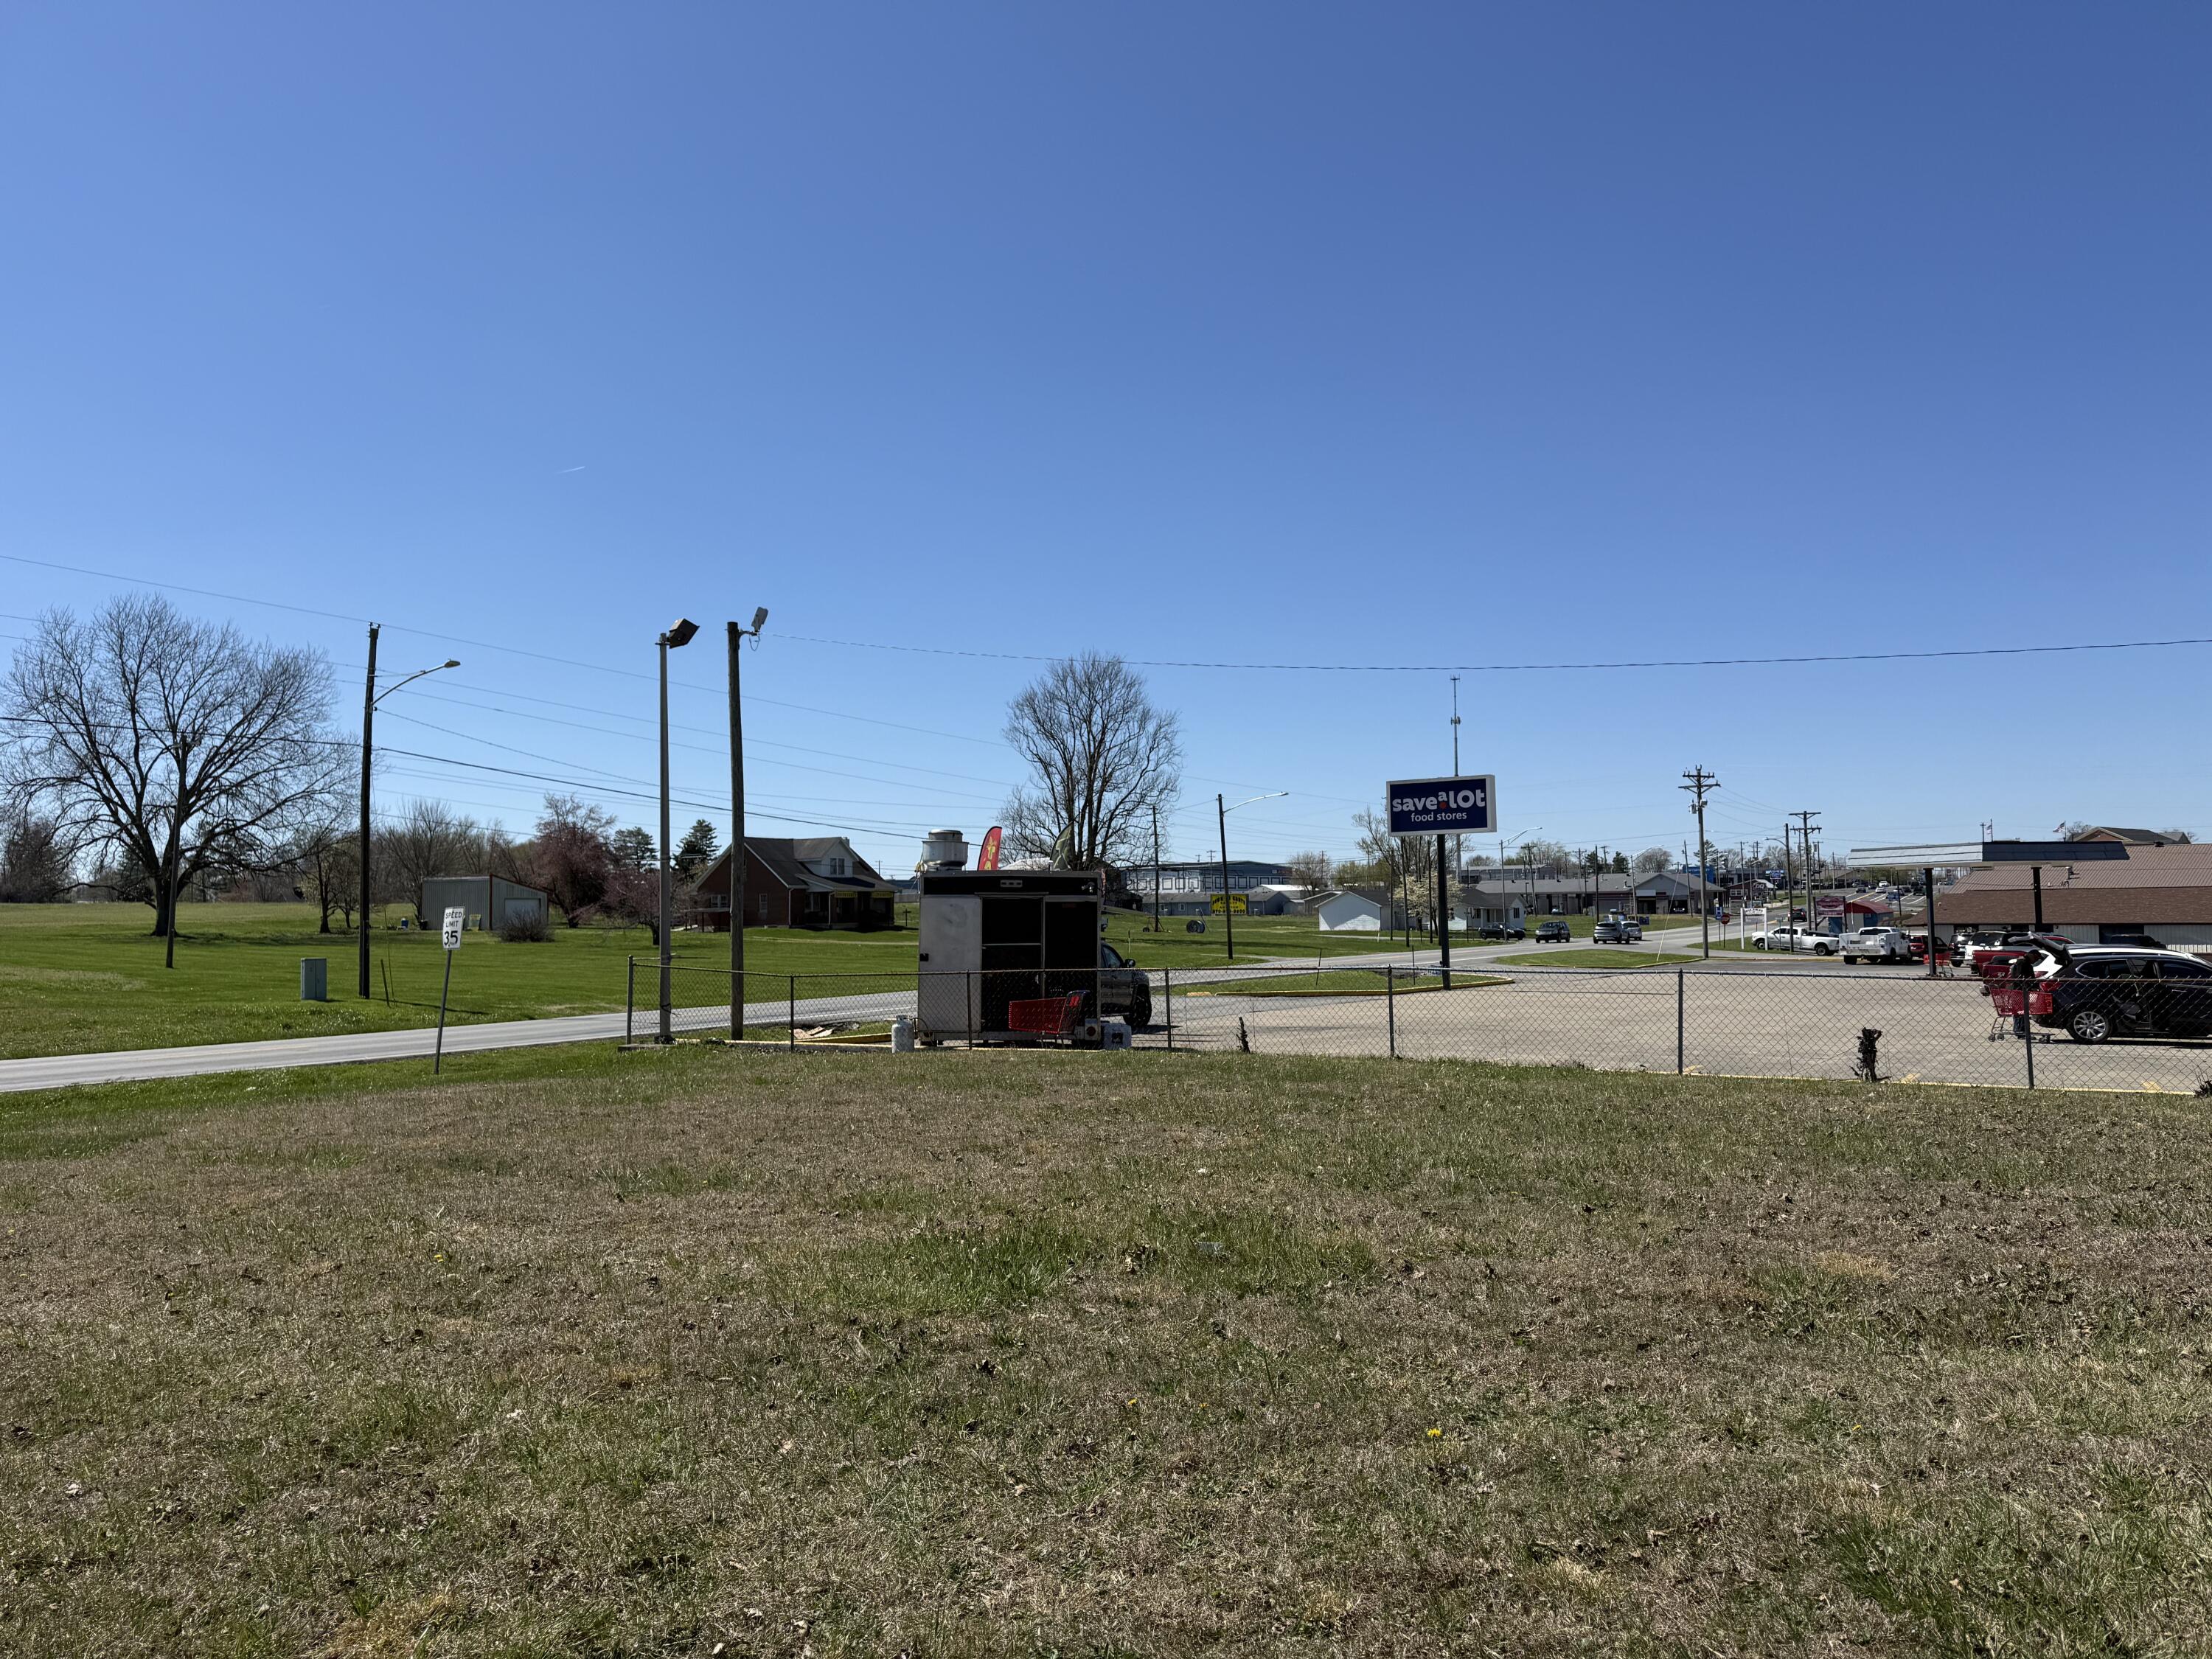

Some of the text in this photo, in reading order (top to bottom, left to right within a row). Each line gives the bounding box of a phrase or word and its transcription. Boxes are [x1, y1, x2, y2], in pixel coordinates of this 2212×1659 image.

[1411, 812, 1467, 822] food stores
[444, 930, 459, 945] 35
